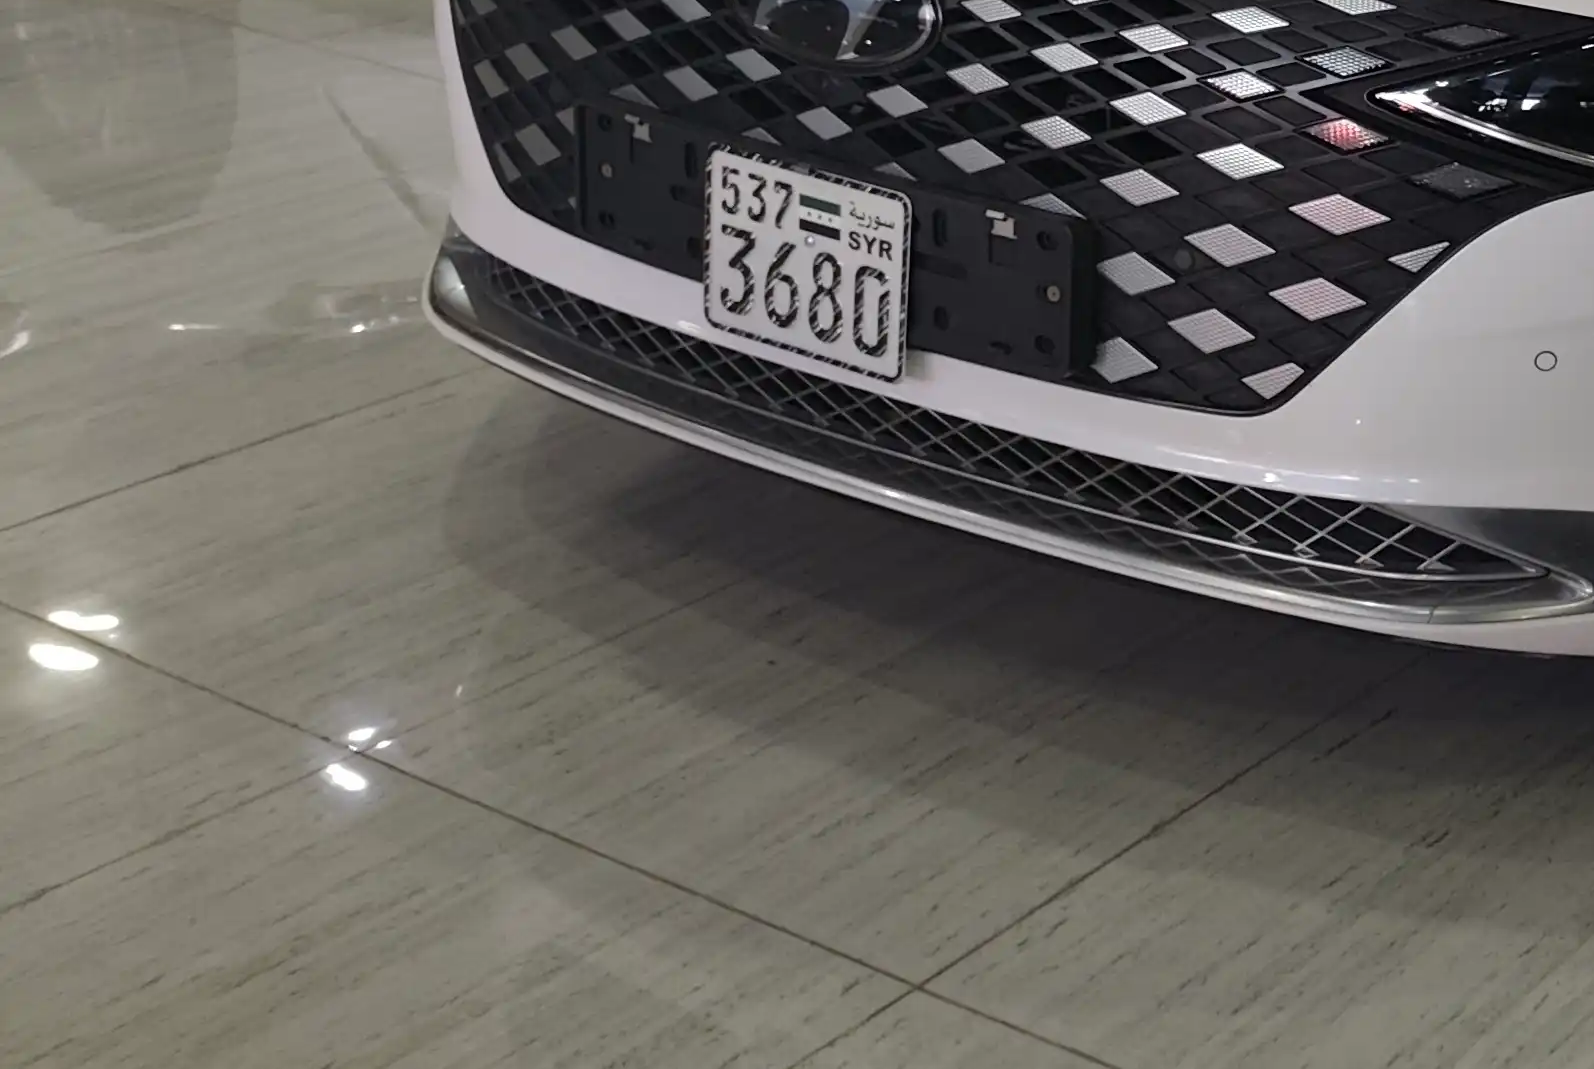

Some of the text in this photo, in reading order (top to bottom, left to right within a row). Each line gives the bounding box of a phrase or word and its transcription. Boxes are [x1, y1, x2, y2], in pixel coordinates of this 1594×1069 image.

[721, 166, 793, 229] 537
[848, 201, 896, 230] سورية
[848, 231, 893, 261] SYR
[720, 224, 891, 357] 3680
